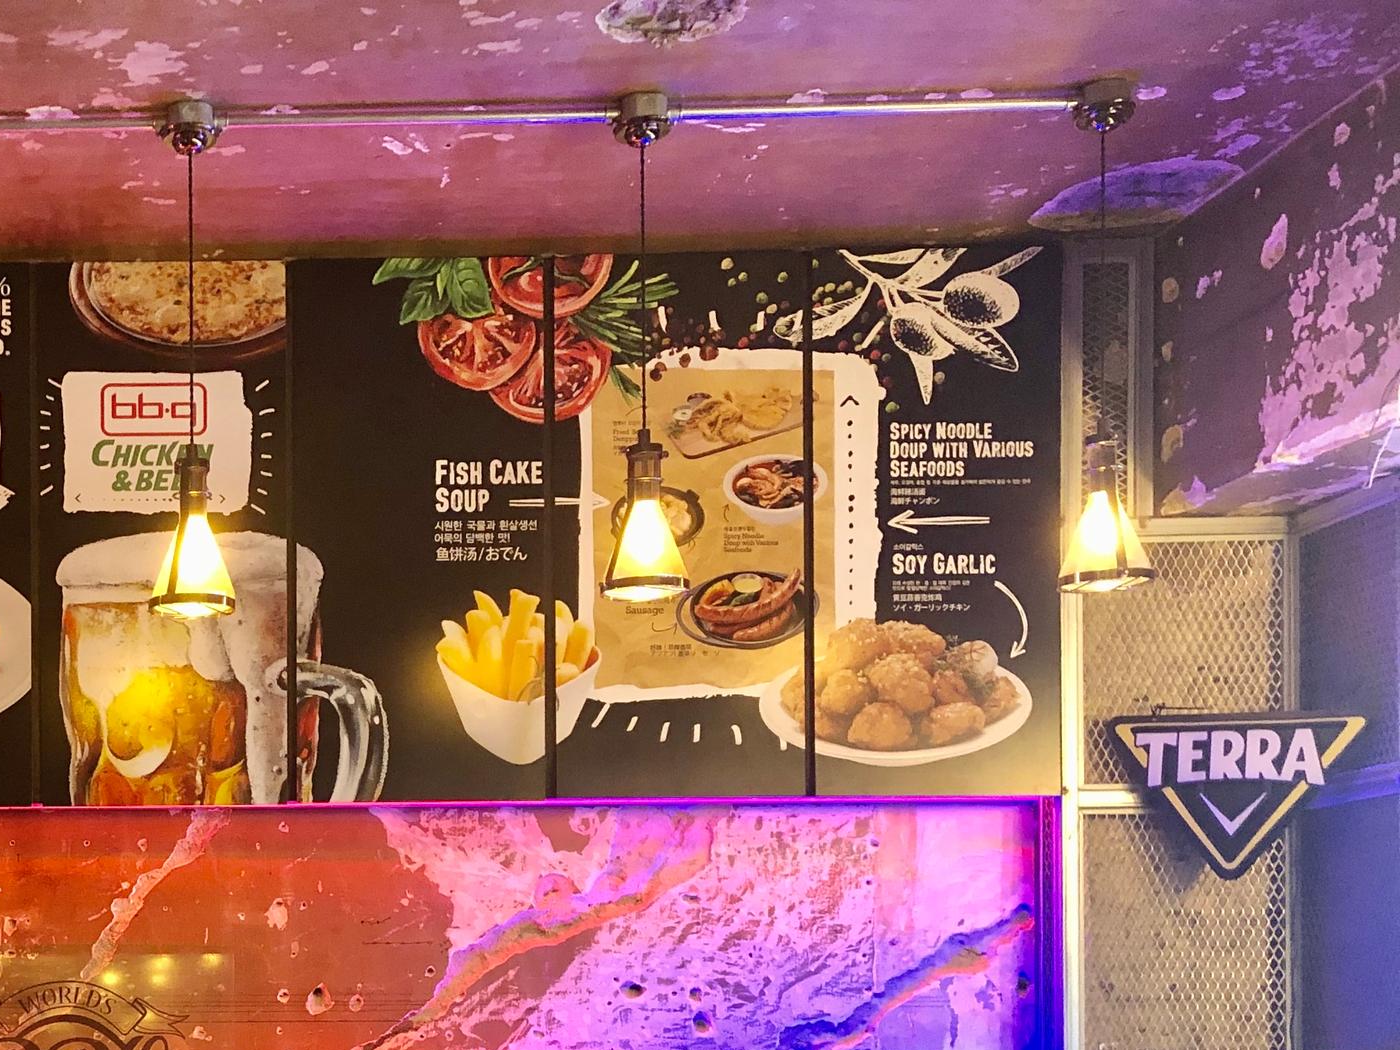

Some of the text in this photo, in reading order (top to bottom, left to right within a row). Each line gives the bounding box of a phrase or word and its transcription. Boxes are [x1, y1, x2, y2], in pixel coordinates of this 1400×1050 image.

[890, 422, 992, 440] SPICY NOODLE
[973, 441, 1034, 458] VARIOUS
[435, 459, 543, 485] FISH CAKE
[890, 460, 965, 478] SEAFOODS
[435, 487, 490, 513] SOUP
[892, 553, 996, 575] SOY GARLIC
[625, 606, 664, 616] Sausage
[1135, 727, 1326, 787] TERRA
